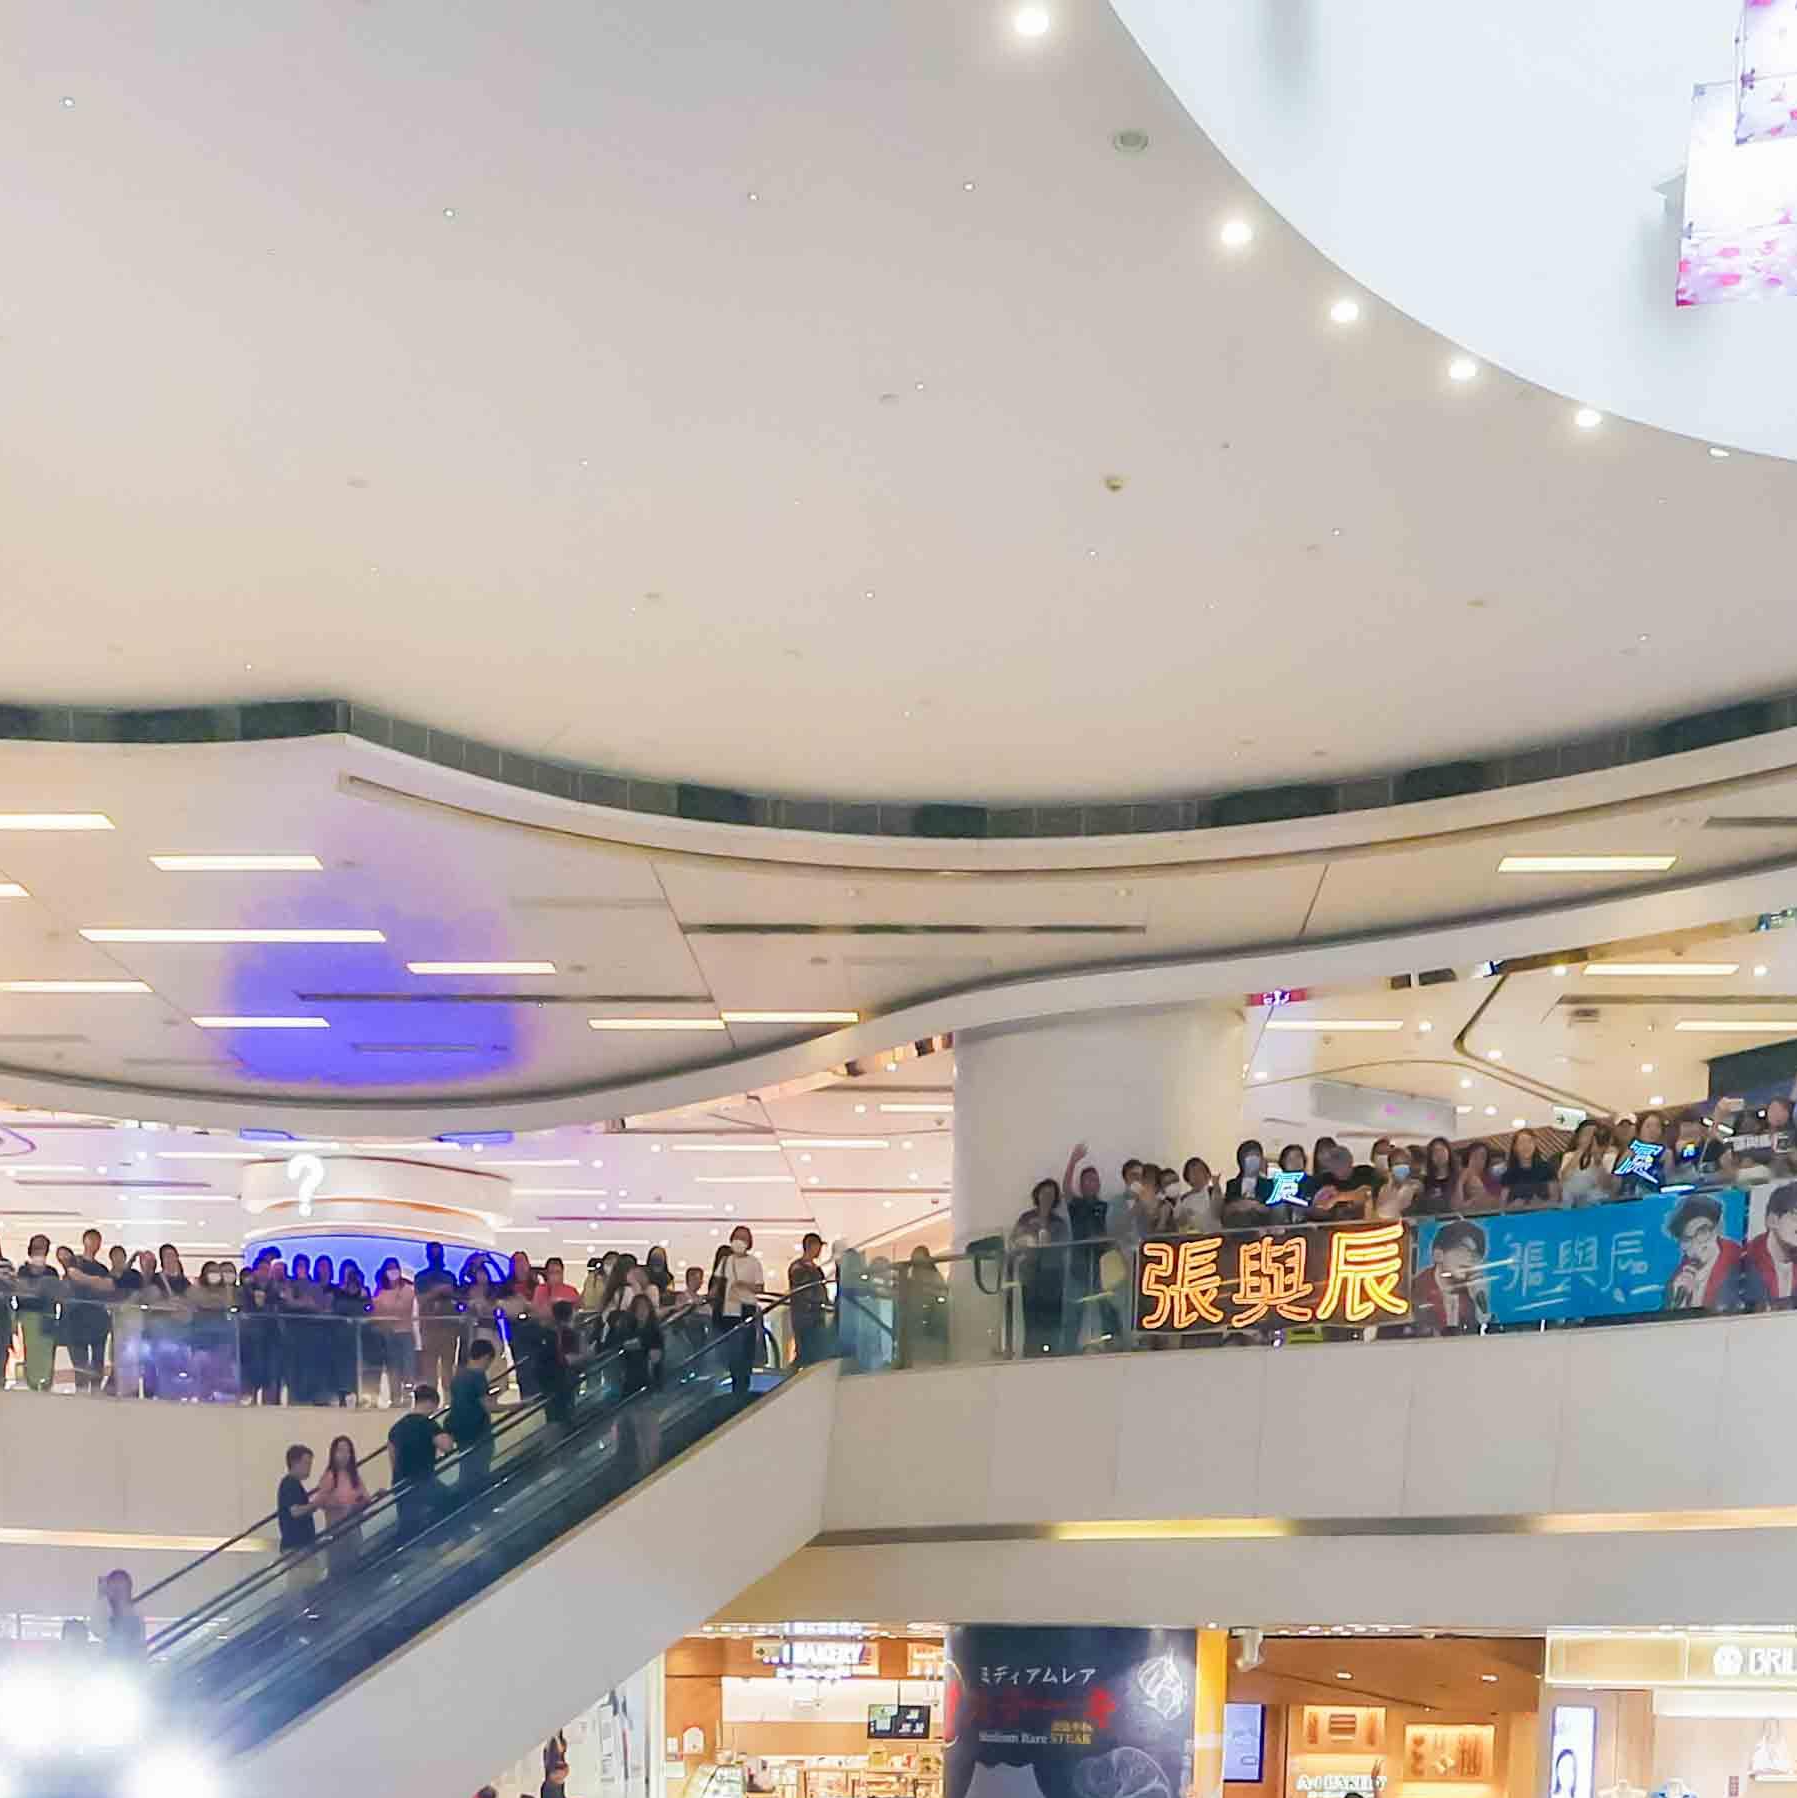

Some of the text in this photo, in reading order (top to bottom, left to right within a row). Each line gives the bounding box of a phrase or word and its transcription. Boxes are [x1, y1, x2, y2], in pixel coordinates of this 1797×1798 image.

[1142, 1223, 1410, 1332] 張與辰
[1504, 1228, 1653, 1297] 張與辰
[978, 1666, 1097, 1687] ミディアムレア
